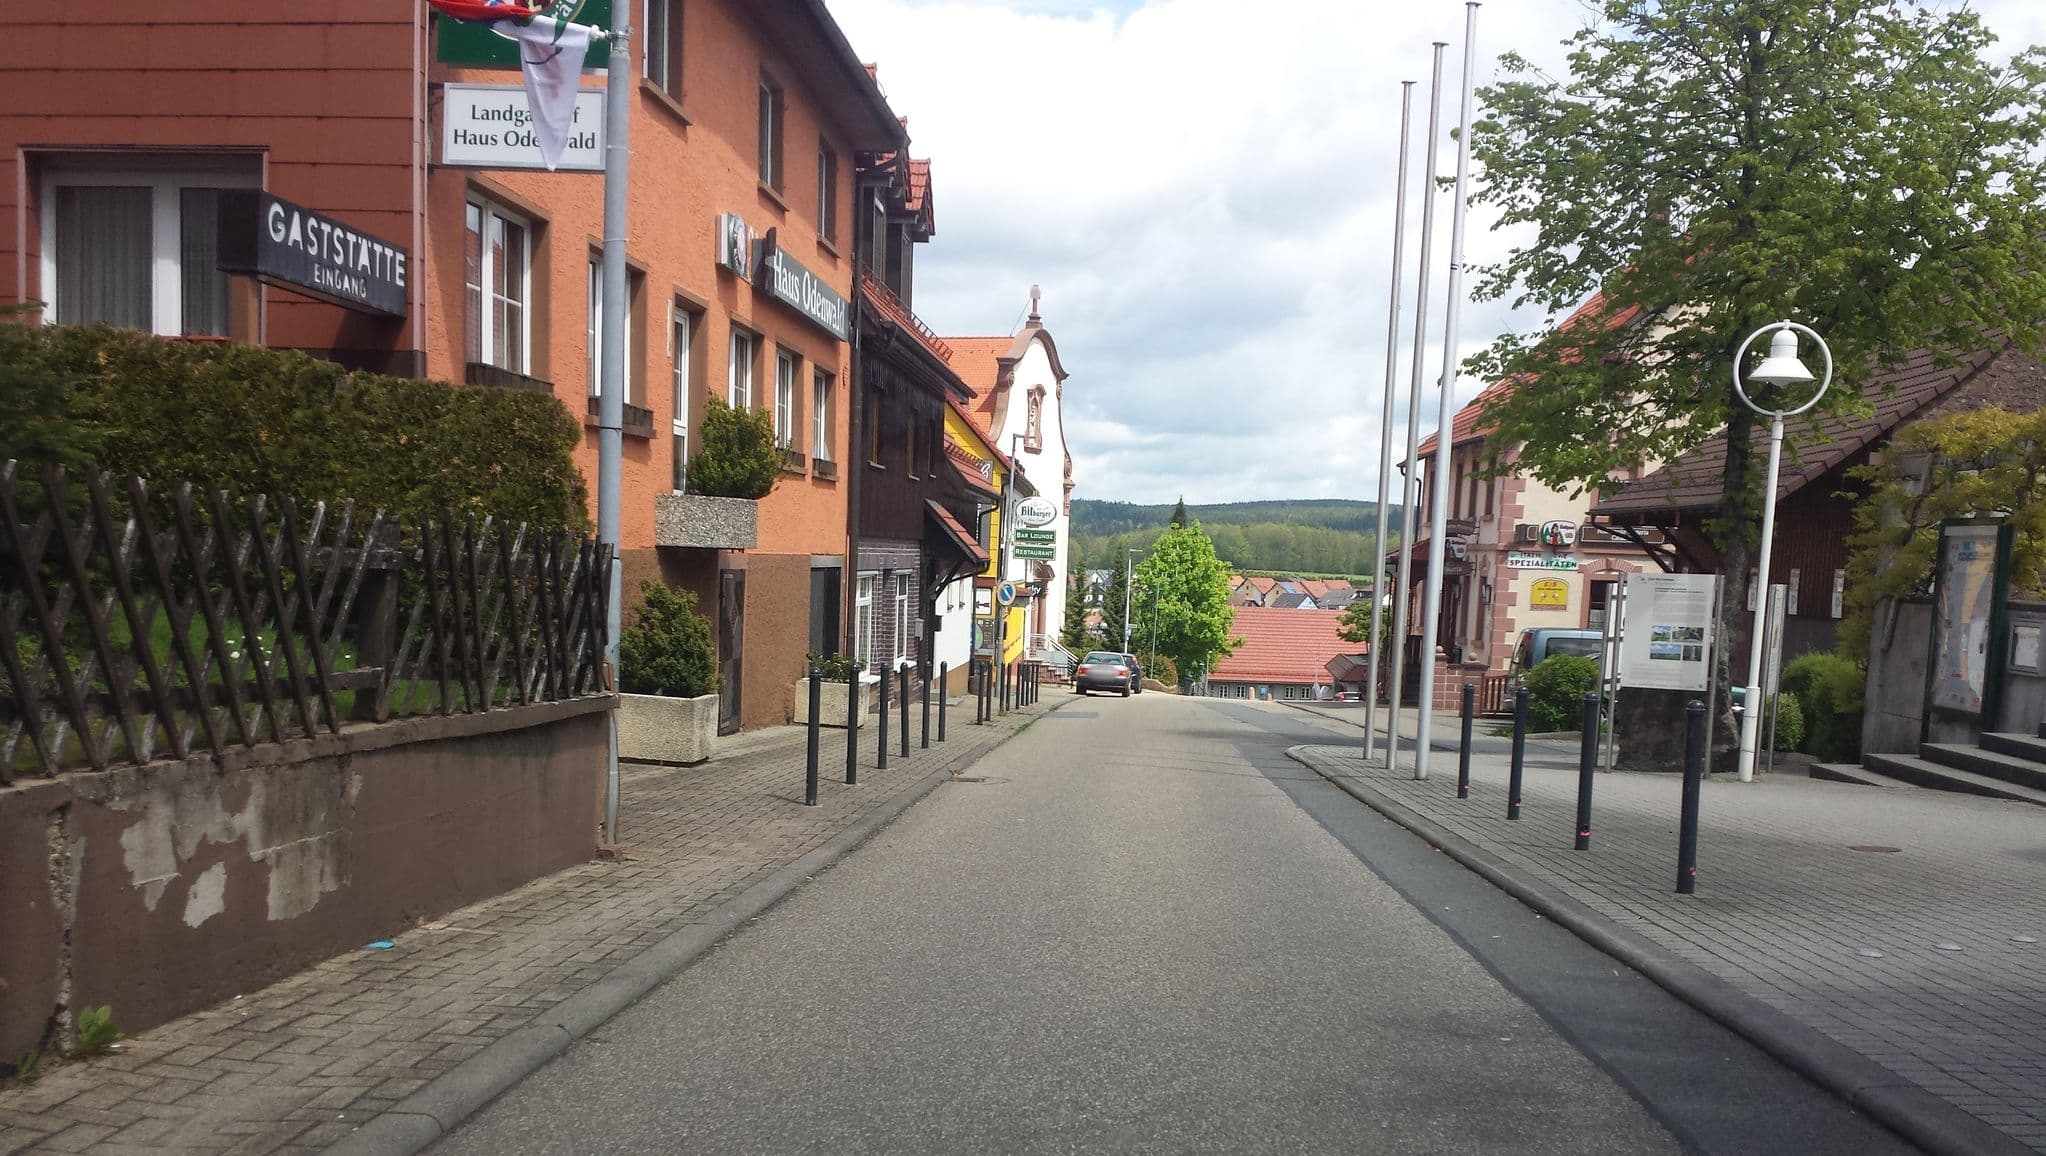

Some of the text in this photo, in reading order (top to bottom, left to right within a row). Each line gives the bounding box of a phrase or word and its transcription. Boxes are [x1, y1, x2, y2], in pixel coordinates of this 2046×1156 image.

[471, 104, 580, 127] Landgaf
[453, 129, 596, 149] Haus Odeald
[268, 202, 406, 287] GASTSTÄTTE
[314, 263, 367, 298] EINGANG
[773, 247, 845, 335] Haus Odenwald
[1015, 548, 1053, 556] RESTAURANT
